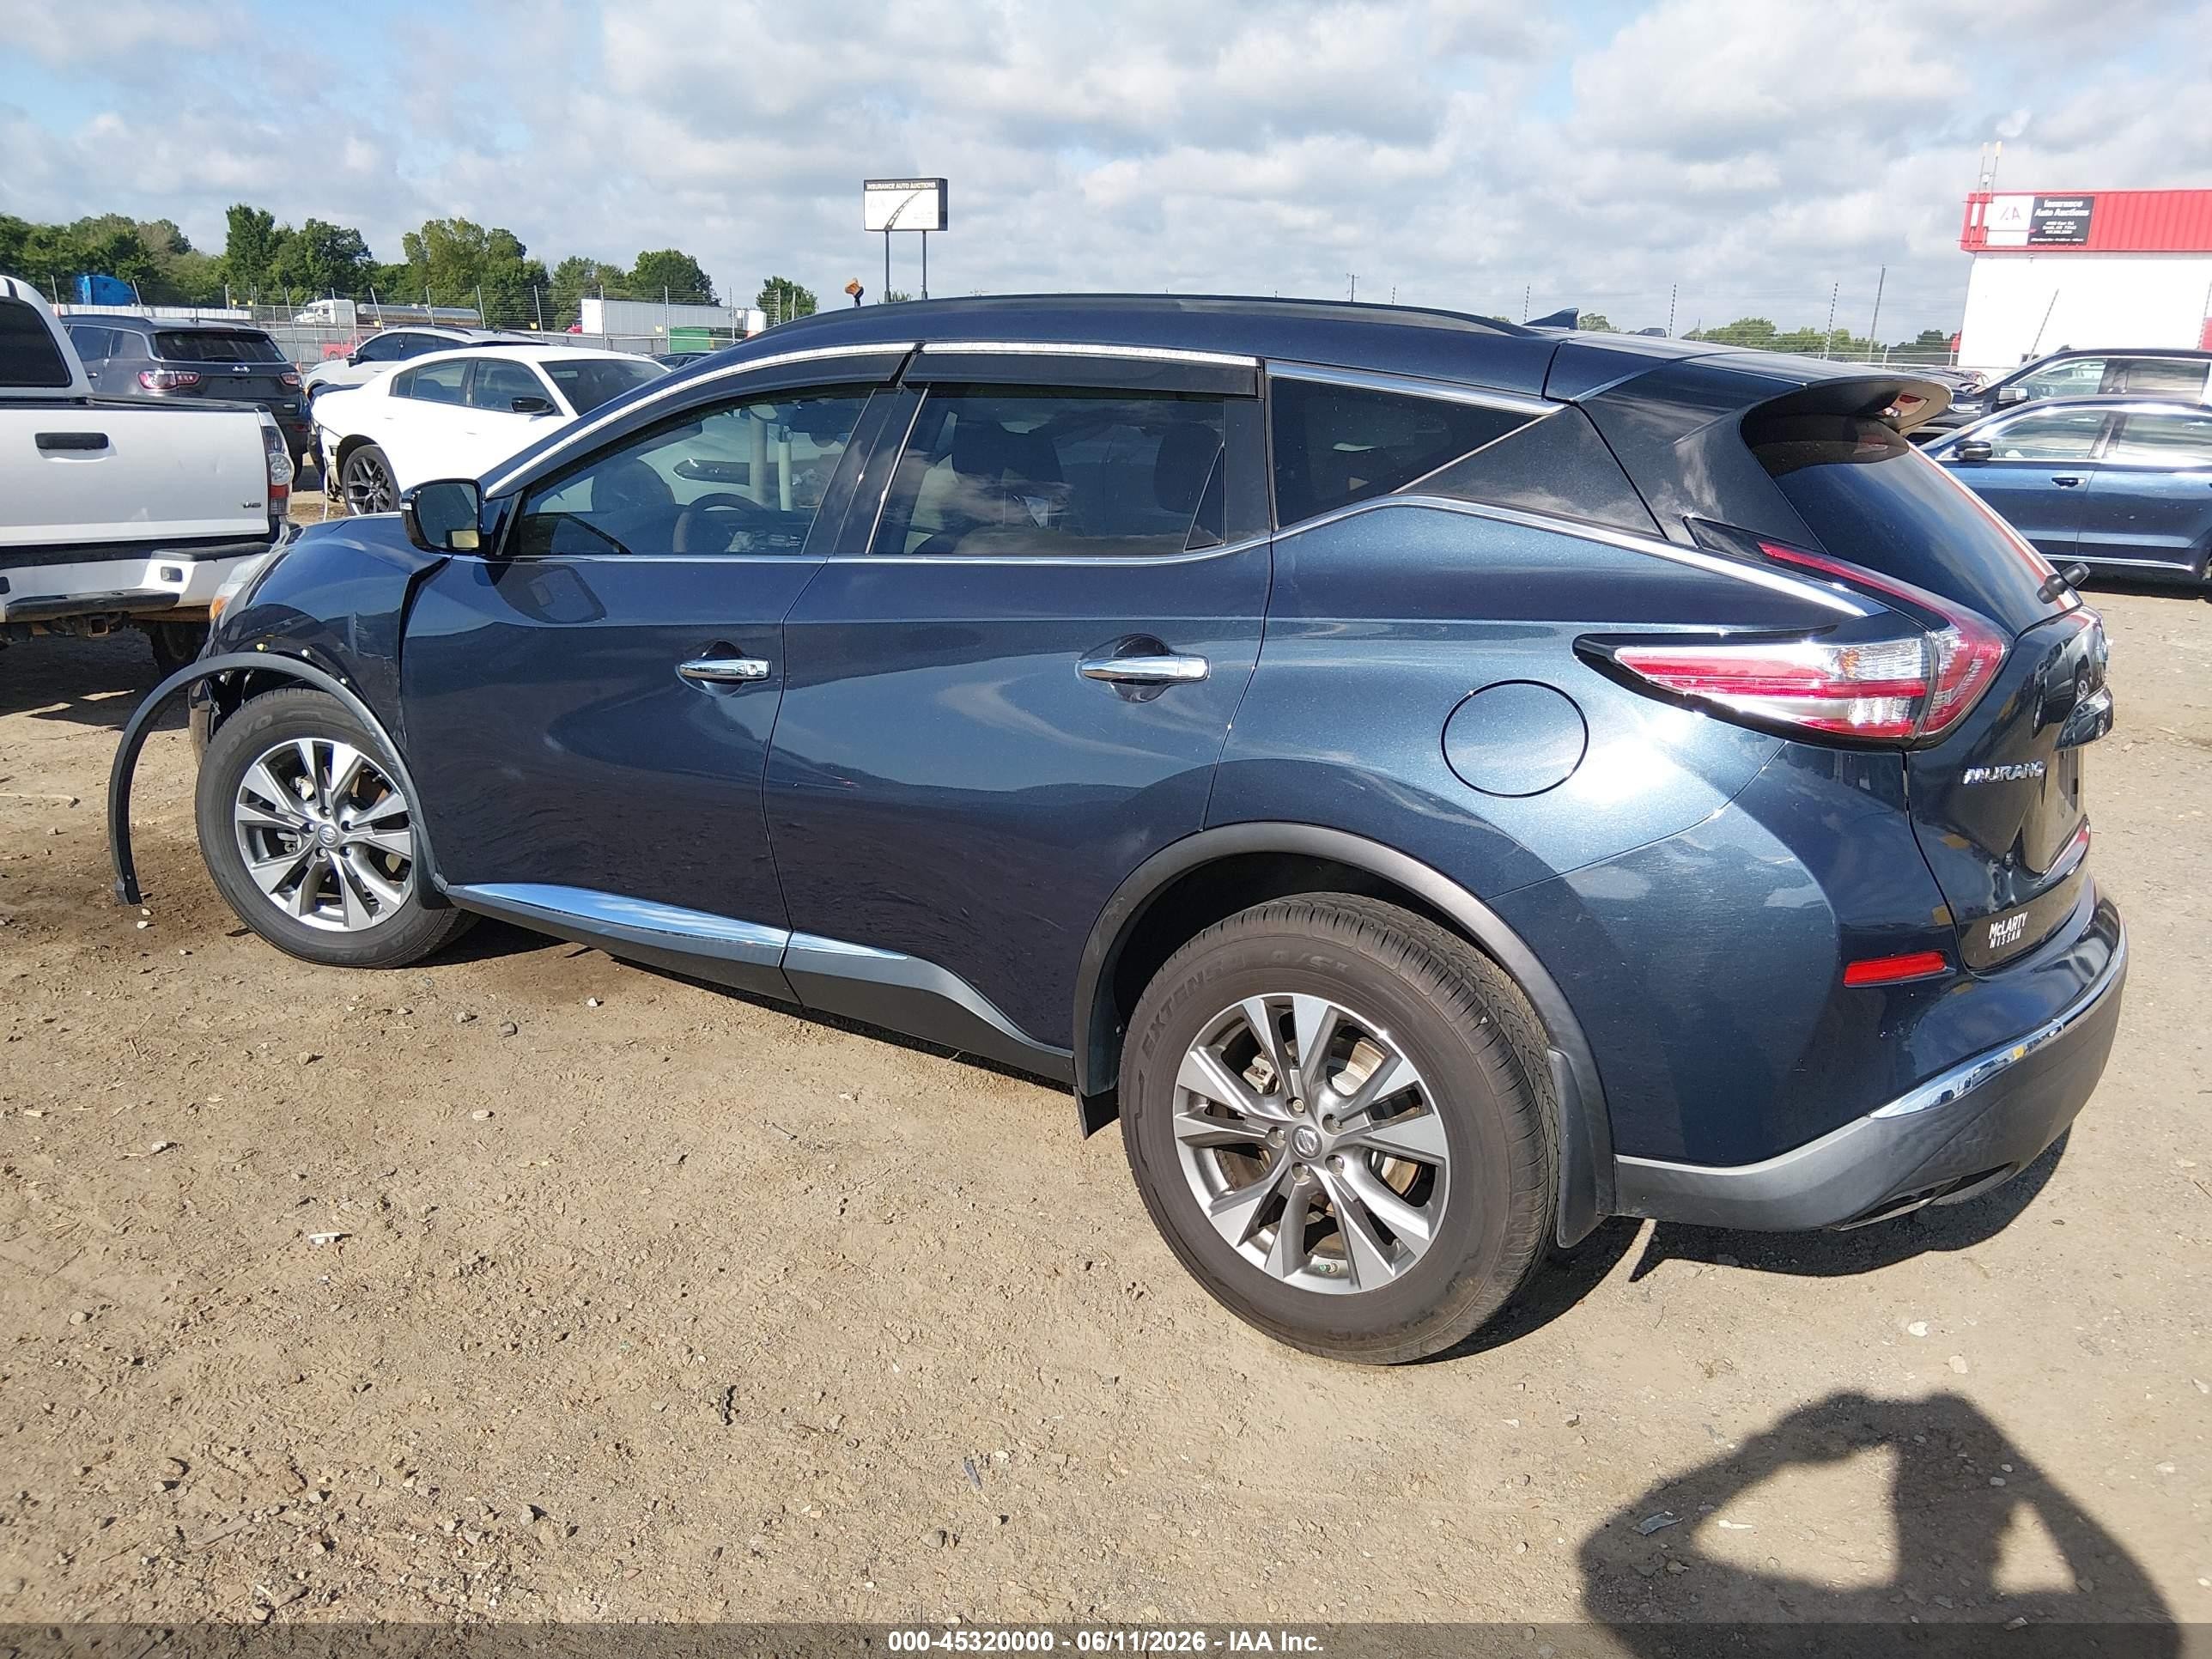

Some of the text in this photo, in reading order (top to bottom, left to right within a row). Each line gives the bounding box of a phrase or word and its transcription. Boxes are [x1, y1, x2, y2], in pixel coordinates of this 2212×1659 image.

[1963, 761, 2045, 785] MURANO
[1988, 911, 2028, 939] McLARTY
[1989, 928, 2021, 949] NISSAN
